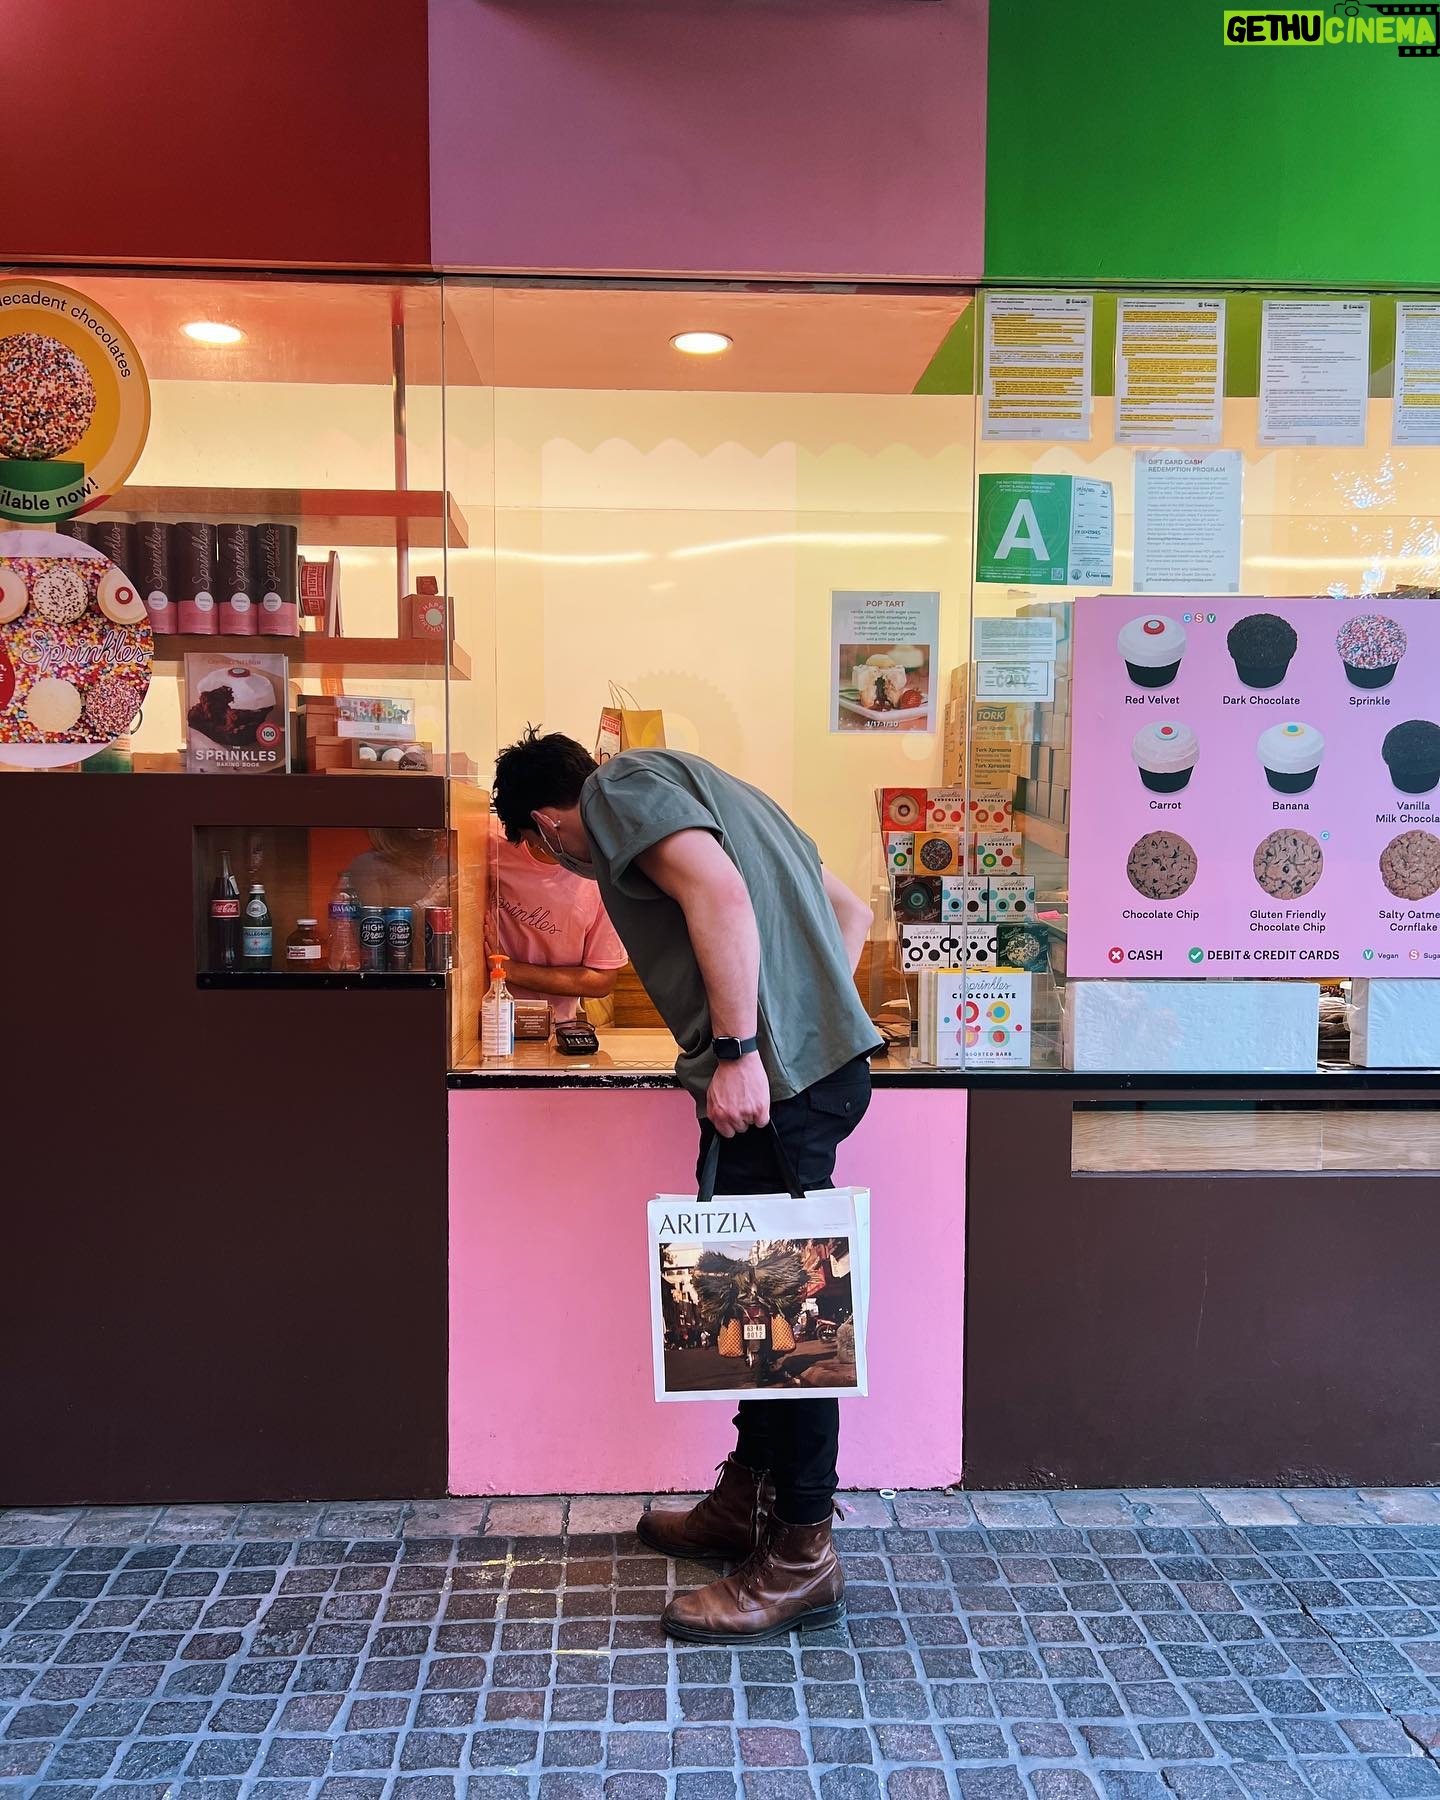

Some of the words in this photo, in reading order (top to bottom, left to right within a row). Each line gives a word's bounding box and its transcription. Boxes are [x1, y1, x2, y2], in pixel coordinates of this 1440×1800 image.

[0, 291, 67, 311] ecadent
[71, 307, 131, 378] chocolates
[56, 477, 99, 508] now!
[994, 499, 1050, 561] A
[145, 522, 167, 589] Sprinkles
[192, 523, 213, 590] Sprinkles
[228, 524, 250, 591] Sprinkles
[263, 524, 281, 591] Sprinkles
[22, 629, 154, 672] Sprinkles
[1125, 696, 1145, 704] Red
[1148, 696, 1180, 704] Velvet
[1223, 696, 1246, 704] Dark
[1250, 696, 1300, 705] Chocolate
[1349, 696, 1390, 707] Sprinkle
[977, 711, 1004, 720] TORK
[195, 751, 277, 761] SPRINKLES
[1149, 801, 1182, 810] Carrot
[1272, 802, 1309, 810] Banana
[1397, 802, 1430, 810] Vanilla
[1375, 814, 1396, 823] Milk
[1122, 910, 1173, 919] Chocolate
[1176, 910, 1200, 920] Chip
[1250, 910, 1283, 919] Gluten
[1286, 910, 1326, 921] Friendly
[1379, 910, 1405, 921] Salty
[1250, 923, 1300, 932] Chocolate
[1303, 923, 1326, 933] Chip
[1390, 923, 1438, 931] Cornflake
[362, 931, 384, 941] Brew
[389, 932, 410, 940] Brew
[1127, 950, 1163, 960] CASH
[1207, 950, 1242, 960] DEBIT
[1243, 950, 1251, 960] &
[1253, 950, 1297, 960] CREDIT
[1299, 950, 1340, 960] CARDS
[659, 1212, 757, 1236] ARITZIA
